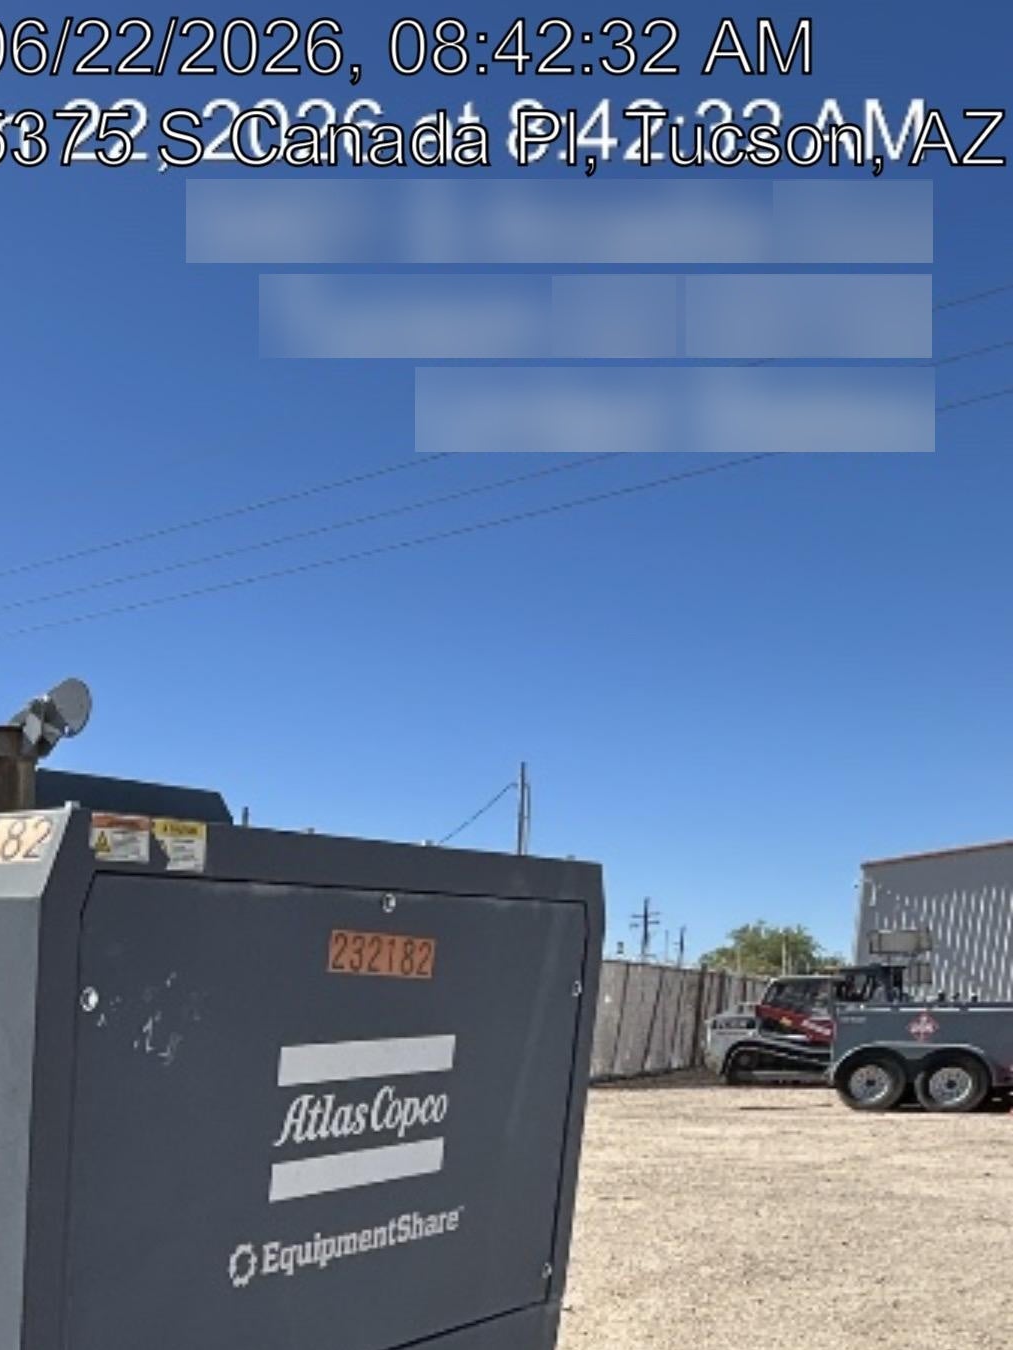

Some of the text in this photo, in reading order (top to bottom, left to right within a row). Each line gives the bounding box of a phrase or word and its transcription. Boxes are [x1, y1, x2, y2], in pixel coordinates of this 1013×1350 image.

[331, 931, 433, 977] 232182
[273, 1084, 449, 1147] Atlas Copco
[260, 1207, 459, 1276] EquipmentShare
